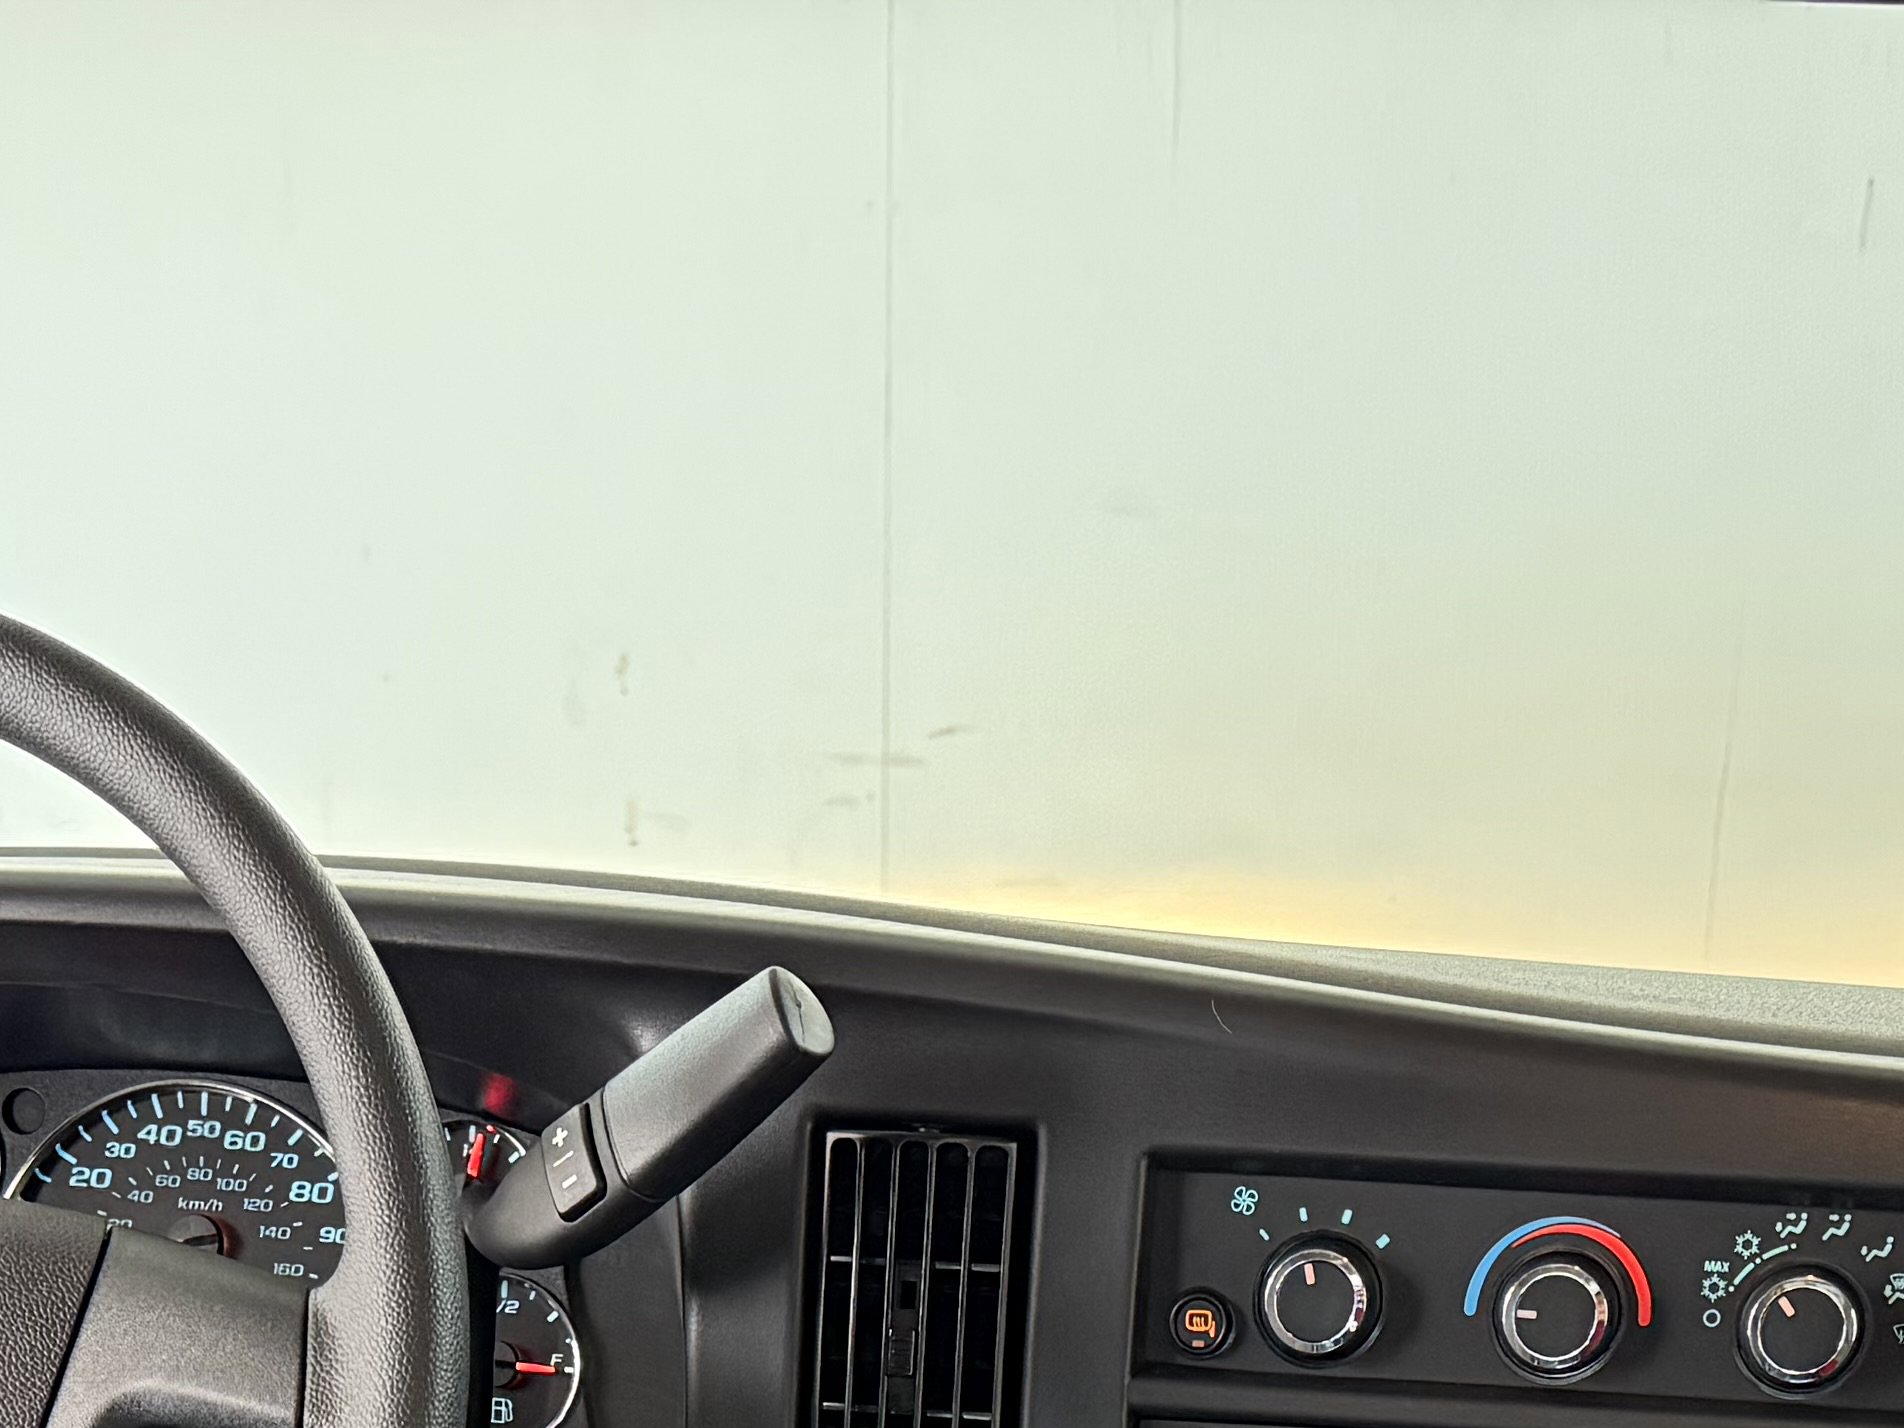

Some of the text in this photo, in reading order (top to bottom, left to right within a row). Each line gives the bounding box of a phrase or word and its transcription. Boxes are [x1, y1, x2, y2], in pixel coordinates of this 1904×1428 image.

[136, 1124, 182, 1147] 40
[186, 1120, 221, 1138] 50
[224, 1130, 266, 1152] 60
[104, 1142, 136, 1159] 30
[270, 1152, 298, 1169] 70
[68, 1168, 112, 1190] 20
[155, 1174, 180, 1188] 60
[186, 1168, 212, 1181] 80
[216, 1178, 248, 1192] 100
[288, 1180, 335, 1204] 80
[127, 1190, 154, 1204] 40
[177, 1197, 223, 1212] km/h
[243, 1198, 274, 1212] 120
[259, 1225, 291, 1240] 140
[273, 1262, 304, 1277] 160
[1704, 1260, 1730, 1272] MAX
